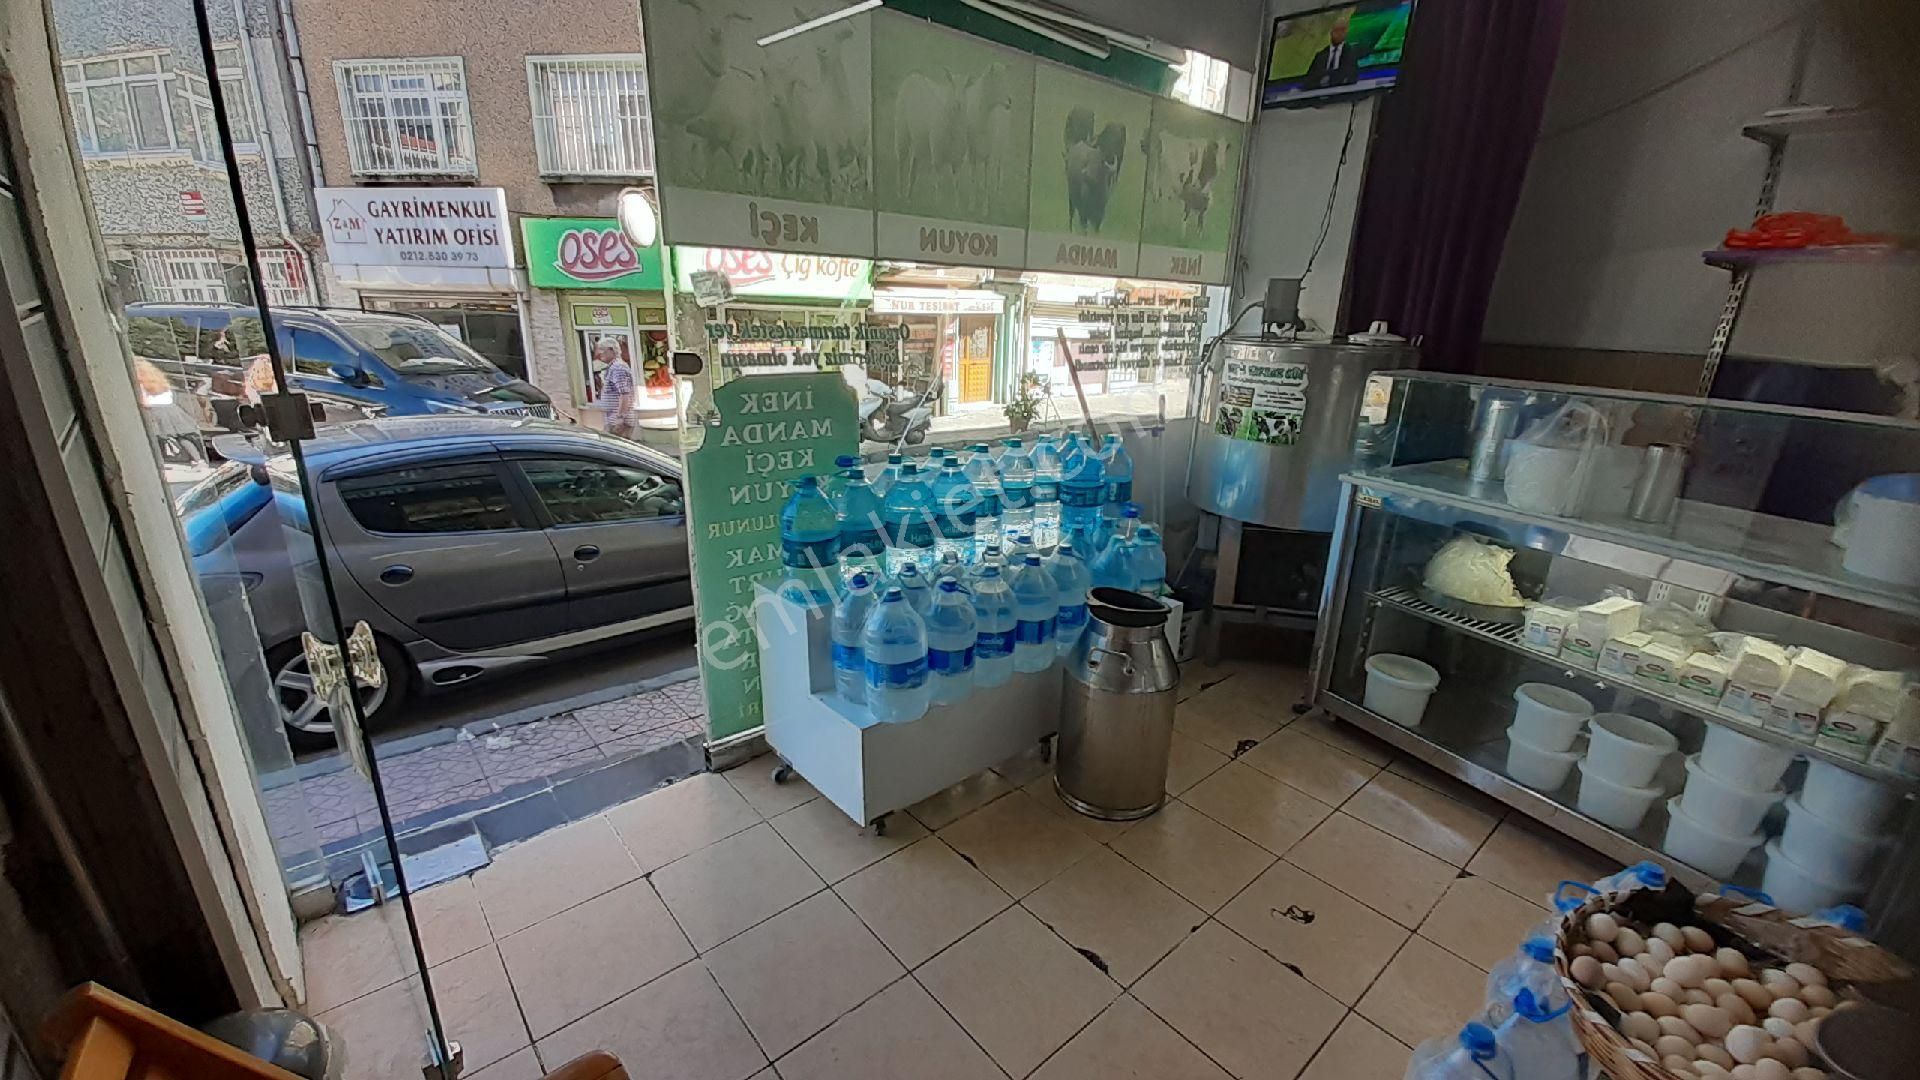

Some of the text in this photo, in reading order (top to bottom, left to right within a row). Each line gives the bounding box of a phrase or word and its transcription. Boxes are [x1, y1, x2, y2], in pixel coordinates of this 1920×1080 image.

[367, 196, 497, 218] GAYRİMENKUL
[374, 224, 499, 246] YATIRIM OFİSİ
[451, 253, 463, 262] 39
[466, 253, 479, 262] 73
